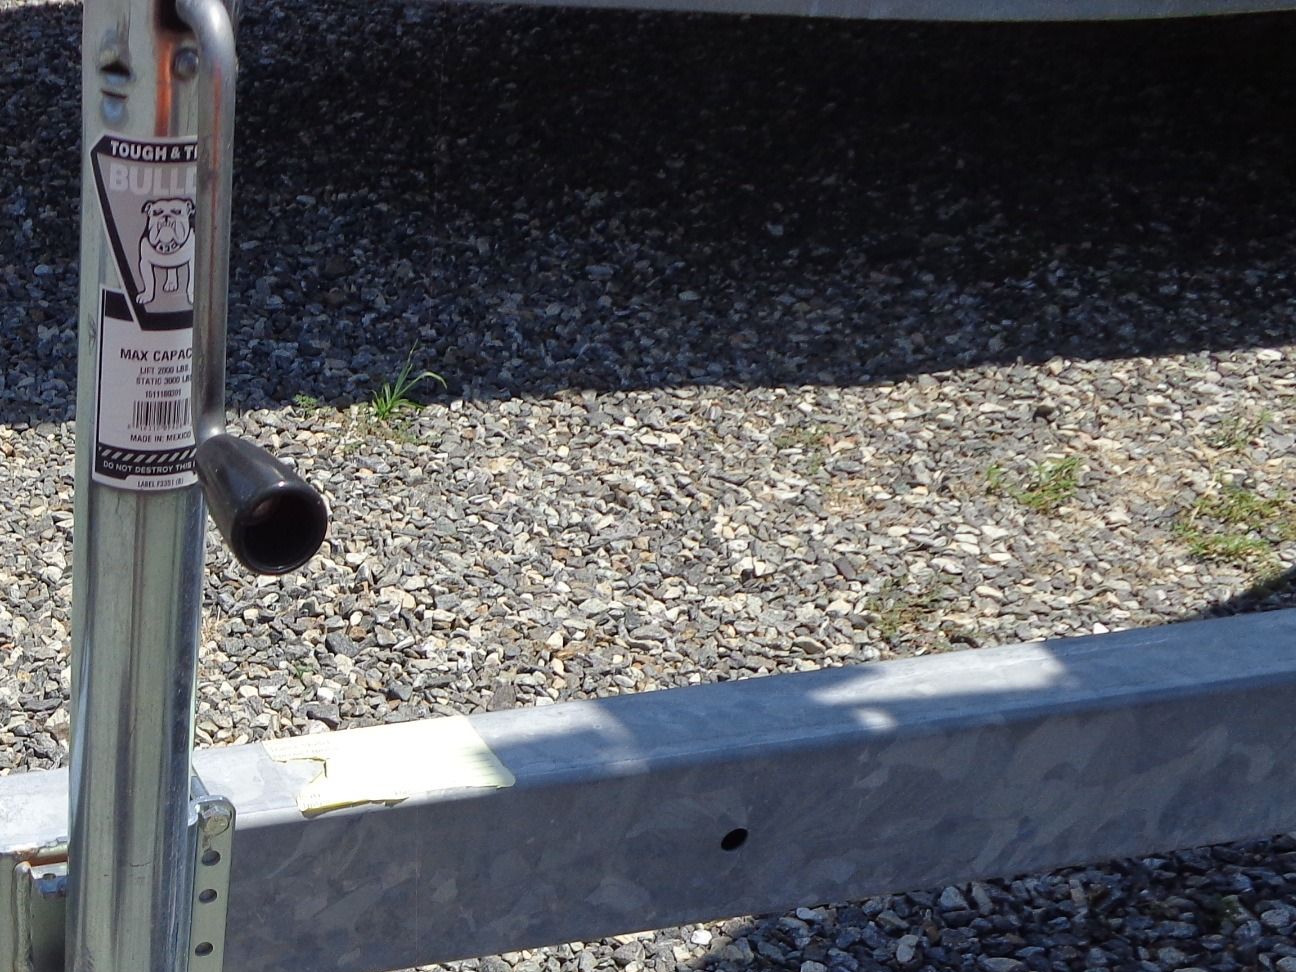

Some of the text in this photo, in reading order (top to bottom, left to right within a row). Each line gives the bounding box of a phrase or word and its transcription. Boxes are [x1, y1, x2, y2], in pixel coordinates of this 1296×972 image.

[110, 140, 167, 161] TOUGH
[170, 146, 181, 159] &
[120, 348, 148, 361] MAX
[140, 367, 155, 375] LIFT
[158, 367, 174, 375] 2000
[136, 377, 161, 386] STATIC
[164, 376, 180, 385] 3000
[130, 434, 151, 442] MADE
[166, 431, 191, 441] MEXICO
[103, 460, 114, 470] DO
[115, 461, 132, 472] NOT
[135, 464, 174, 474] DESTROY
[176, 461, 191, 471] THIS
[137, 480, 155, 488] LABEL
